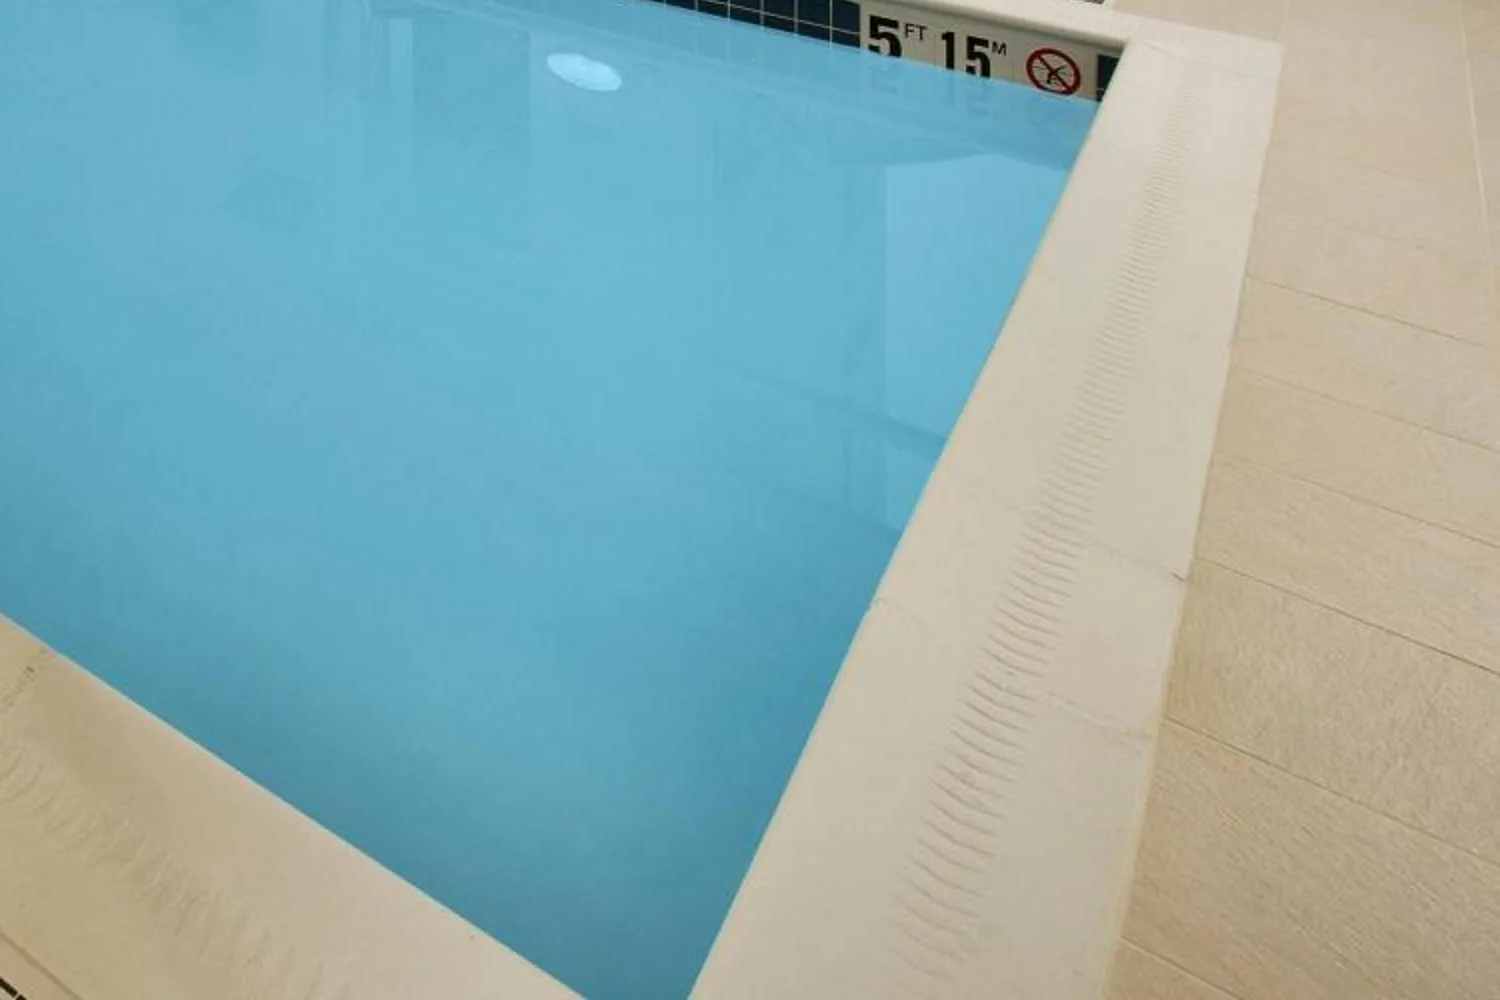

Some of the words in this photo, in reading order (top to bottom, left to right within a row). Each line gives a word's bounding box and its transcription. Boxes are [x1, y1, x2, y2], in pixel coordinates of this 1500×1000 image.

[867, 13, 903, 59] 5
[904, 22, 928, 42] FT
[941, 30, 991, 79] 15
[991, 40, 1008, 57] M
